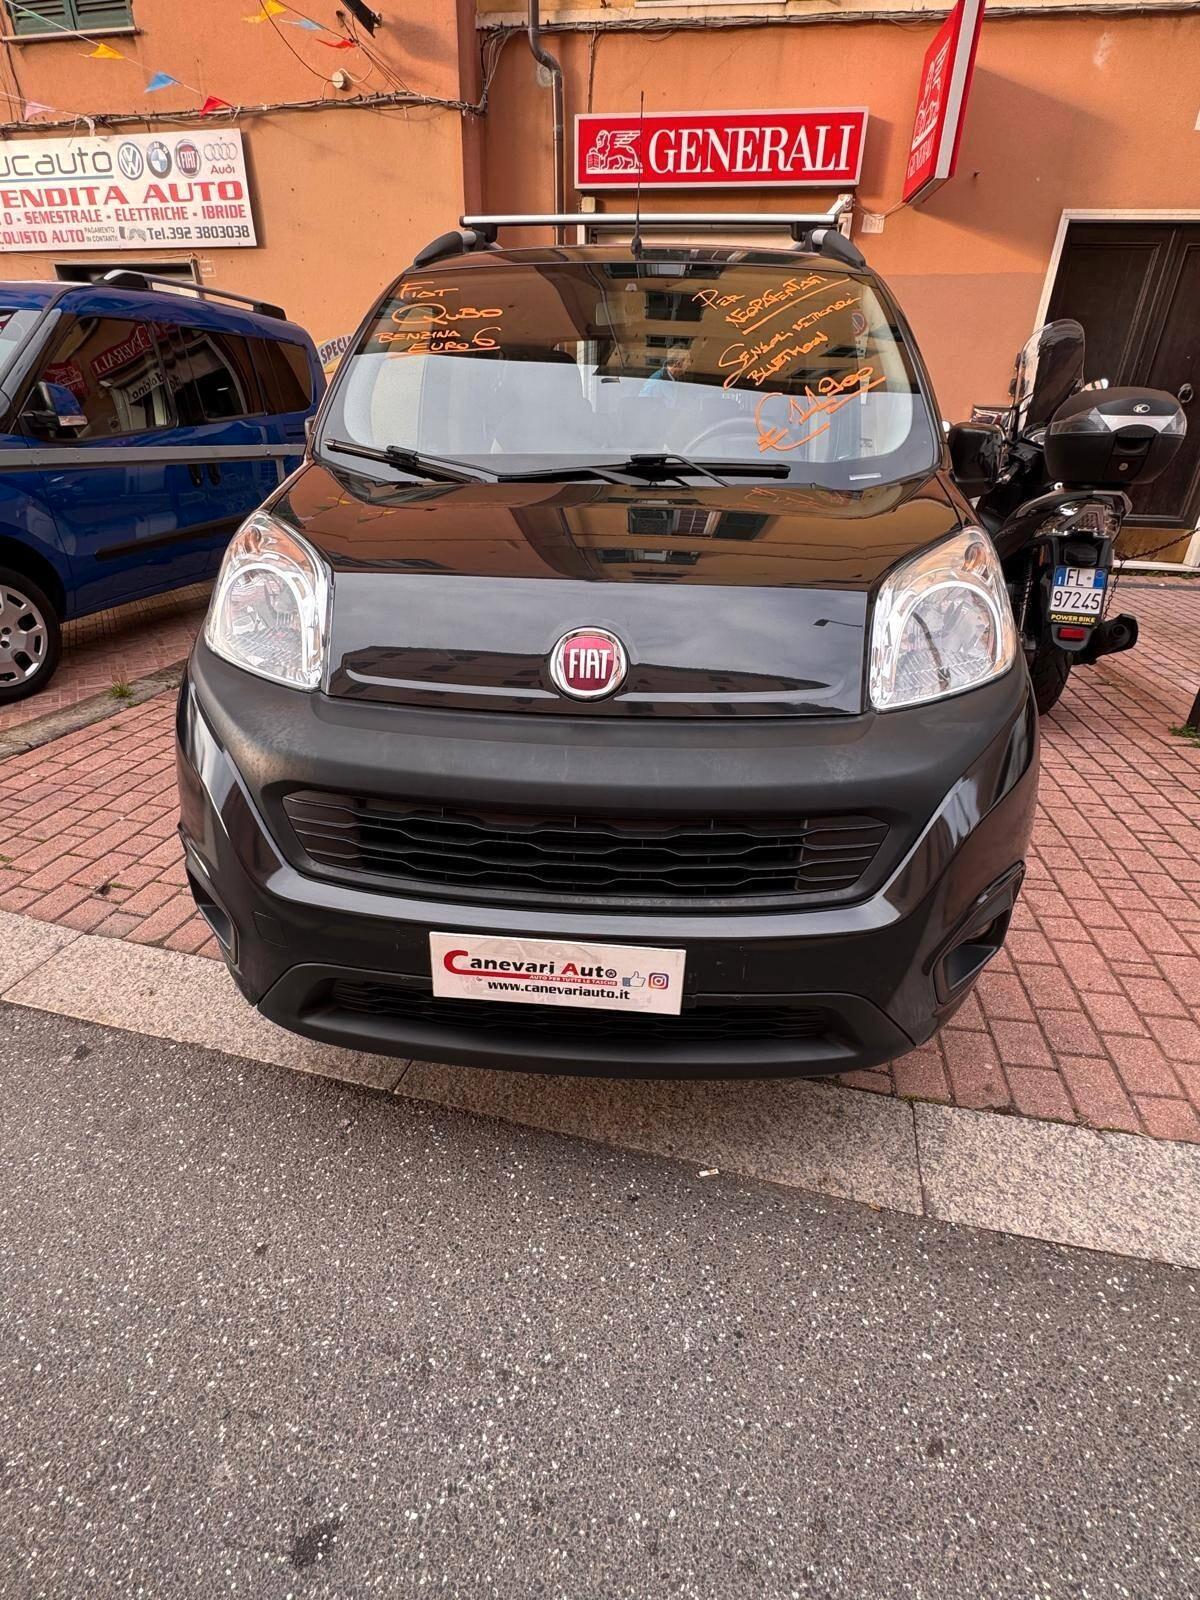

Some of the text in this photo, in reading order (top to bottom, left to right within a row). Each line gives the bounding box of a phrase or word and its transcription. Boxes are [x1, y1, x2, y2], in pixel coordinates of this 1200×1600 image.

[648, 125, 855, 175] GENERALI
[210, 164, 236, 175] Audi
[143, 181, 244, 204] AUTO
[24, 209, 103, 225] SEMESTRALE
[115, 206, 189, 222] ELETTRICHE
[201, 204, 247, 220] IBRIDE
[52, 229, 85, 243] AUTO
[84, 226, 115, 234] PAGAMENTO
[147, 225, 250, 240] Tel.392 3803038
[1066, 568, 1084, 587] FL
[1053, 590, 1101, 610] 97245
[1050, 614, 1078, 622] POWER
[568, 647, 612, 680] FIAT
[443, 949, 555, 976] Canevari
[487, 981, 631, 1000] www.canevariauto.it
